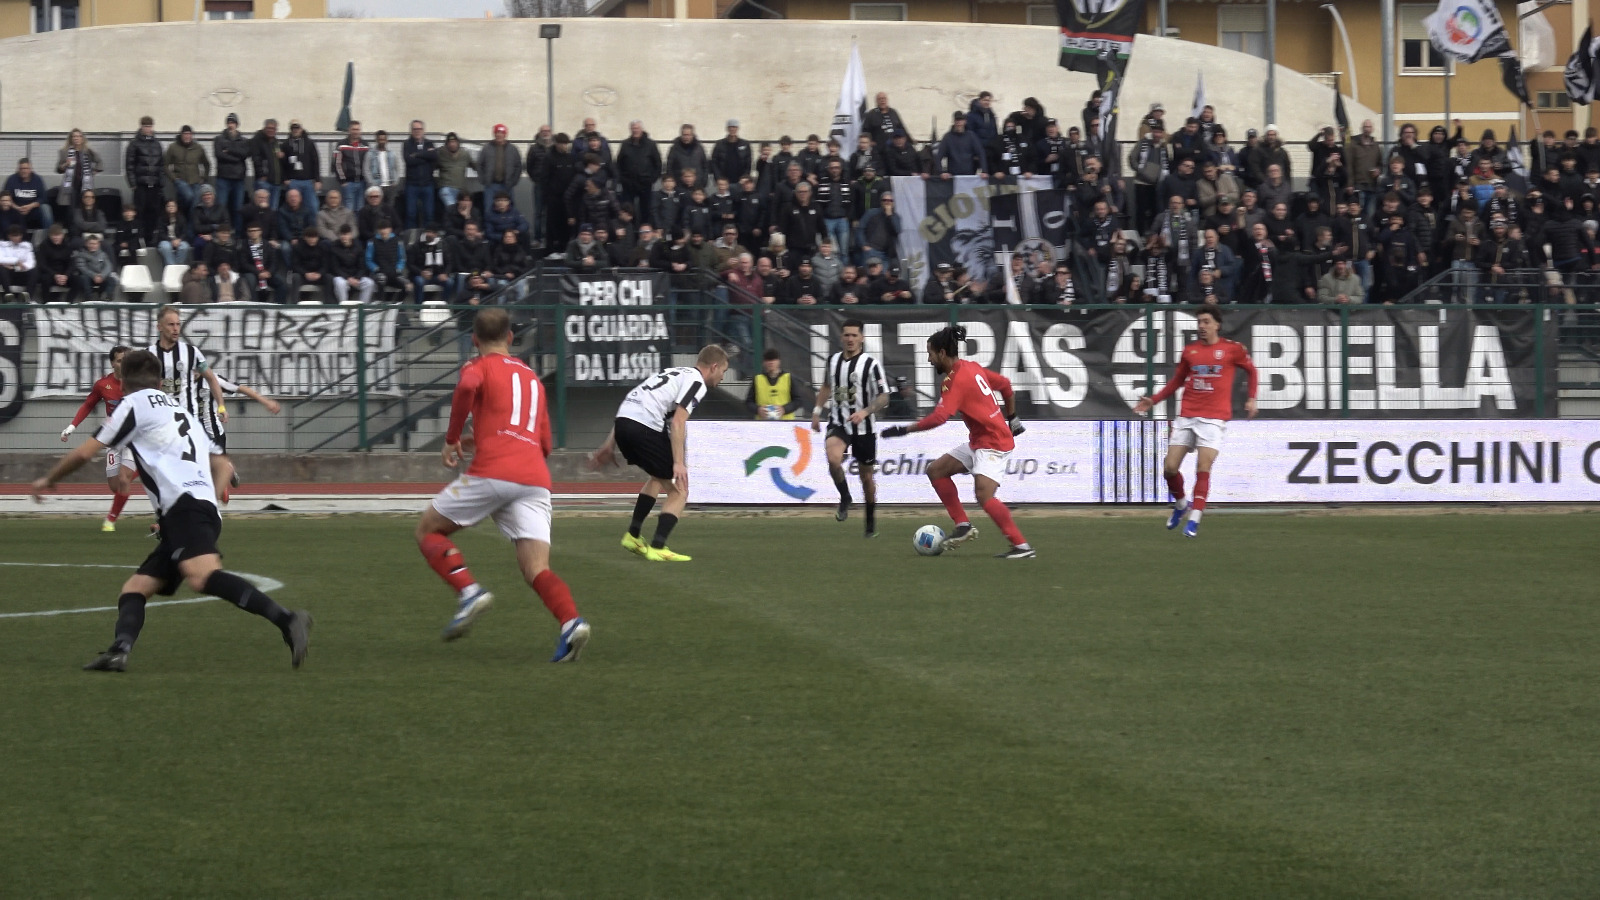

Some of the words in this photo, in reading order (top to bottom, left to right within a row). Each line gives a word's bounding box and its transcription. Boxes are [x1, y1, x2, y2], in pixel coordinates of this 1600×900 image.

[578, 280, 618, 306] PER
[618, 279, 654, 306] CHI
[564, 313, 586, 342] CI
[587, 312, 669, 342] GUARDA
[574, 353, 606, 381] DA
[1251, 324, 1517, 410] BIELLA
[510, 372, 539, 433] 11
[173, 411, 197, 464] 3
[1287, 440, 1561, 485] ZECCHINI
